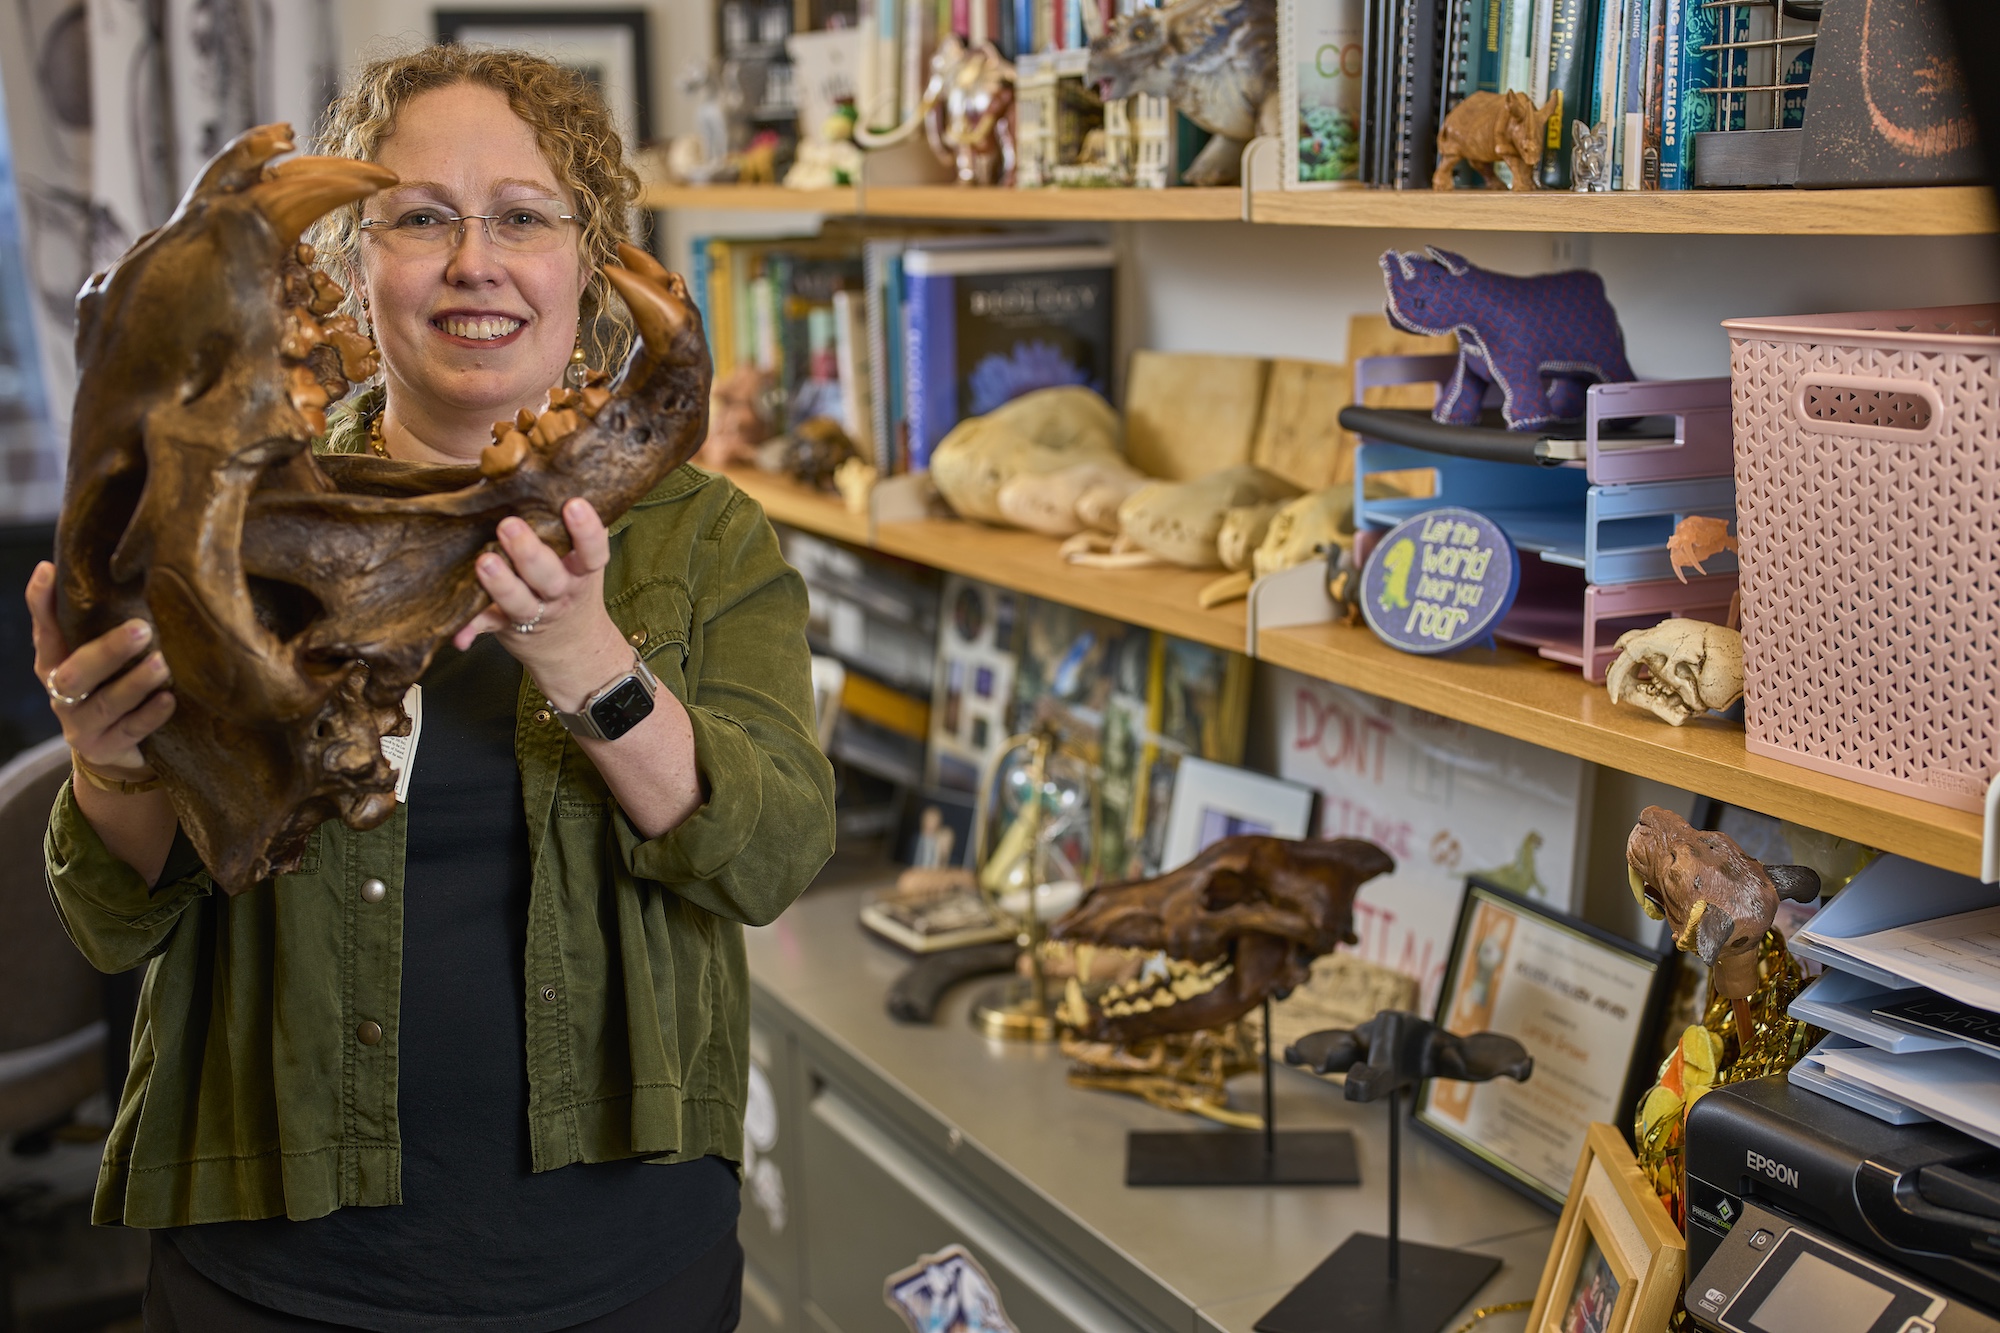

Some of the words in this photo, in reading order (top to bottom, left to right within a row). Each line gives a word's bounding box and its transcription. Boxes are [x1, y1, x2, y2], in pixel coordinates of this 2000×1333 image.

[1665, 35, 1680, 147] INFECTIONS
[1421, 516, 1449, 544] Let
[1451, 522, 1480, 546] the
[1423, 545, 1493, 581] world
[1415, 578, 1453, 600] hear
[1454, 583, 1485, 607] you
[1405, 600, 1469, 641] roar
[1931, 771, 1956, 783] room
[1931, 779, 1978, 796] essentials
[1746, 1149, 1799, 1189] EPSON
